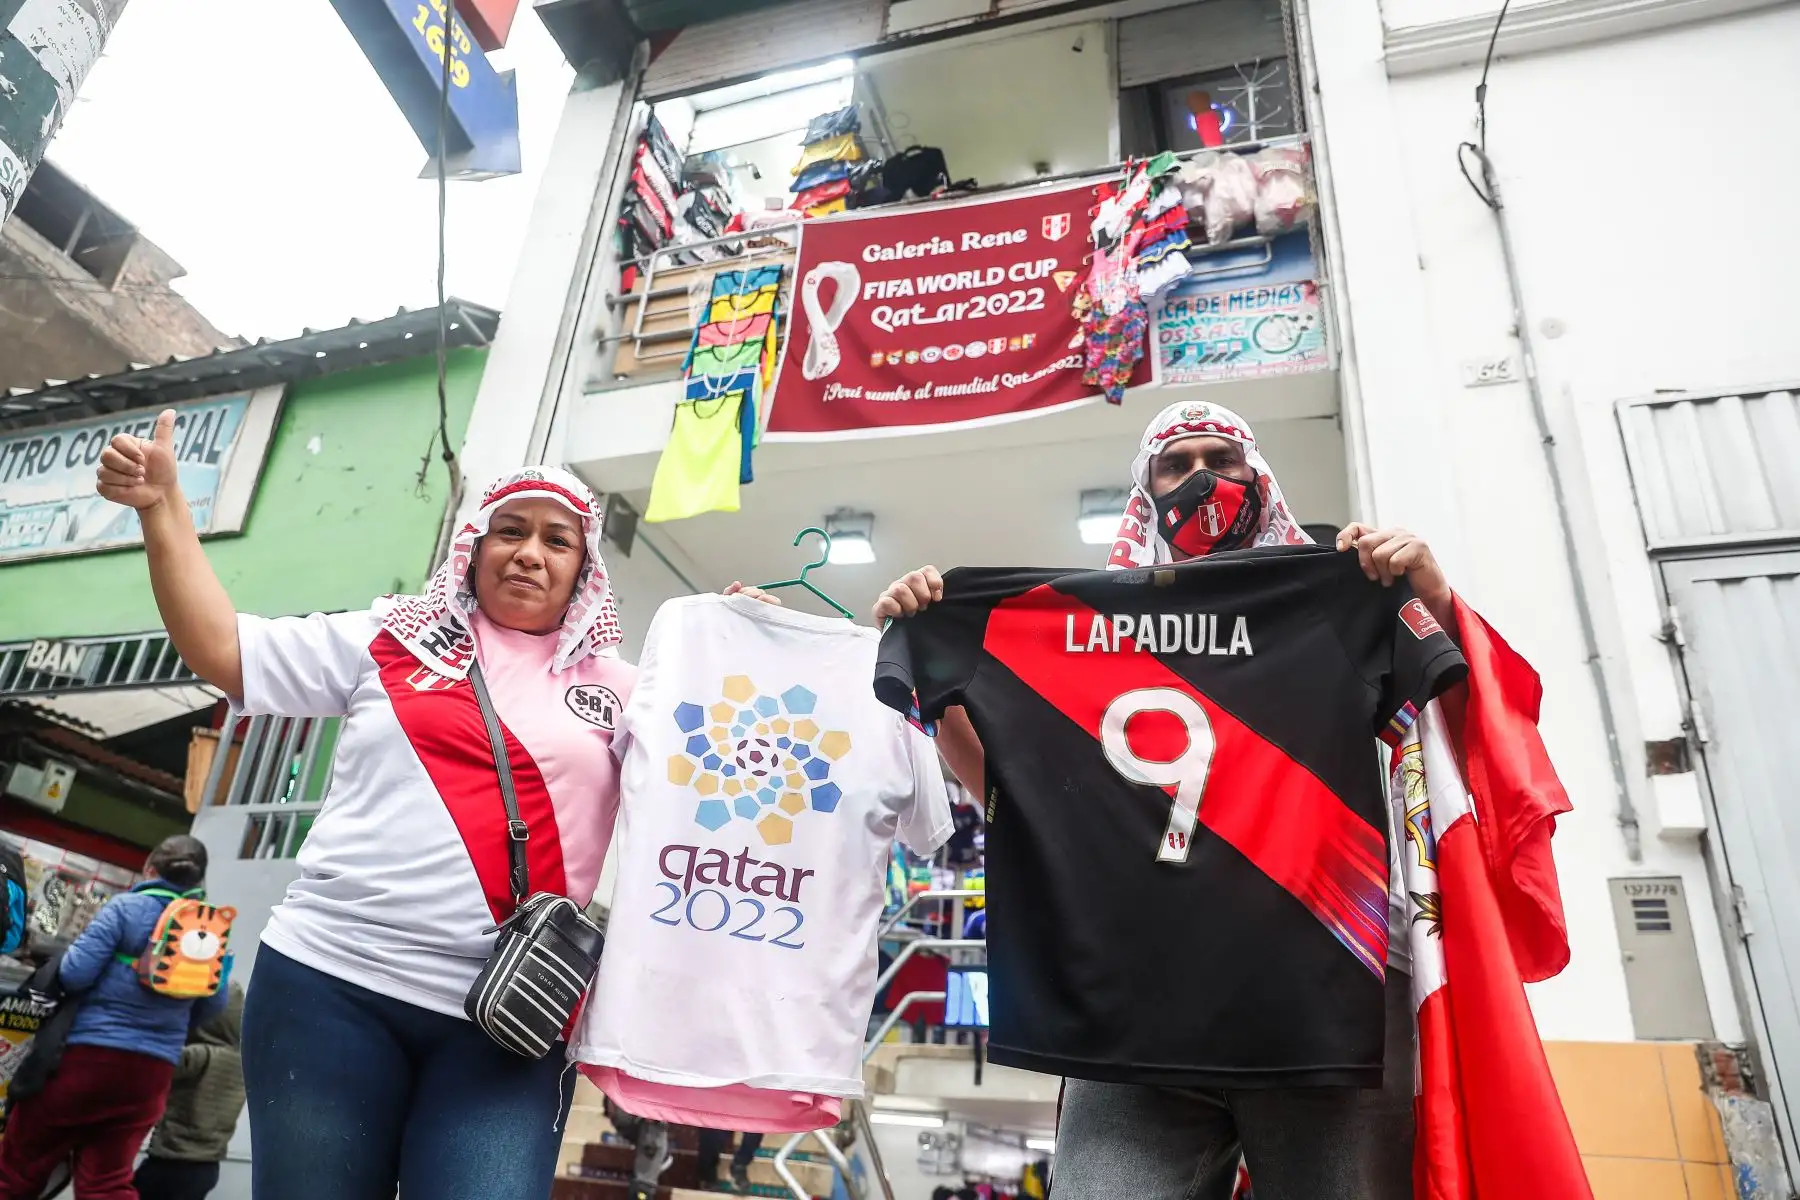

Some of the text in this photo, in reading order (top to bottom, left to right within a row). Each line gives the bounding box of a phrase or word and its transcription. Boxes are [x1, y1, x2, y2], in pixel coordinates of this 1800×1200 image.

[862, 228, 1028, 263] Galeria Rene
[863, 257, 1059, 301] FIFA WORLD CUP
[1196, 295, 1221, 314] DE
[1229, 285, 1303, 309] MEDIAS
[864, 385, 912, 402] rumbo
[914, 381, 932, 400] al
[934, 374, 999, 398] mundial
[1065, 613, 1254, 656] LAPADULA
[574, 688, 614, 726] SBA
[1099, 686, 1217, 863] 9
[658, 843, 815, 904] qatar
[649, 881, 806, 950] 2022
